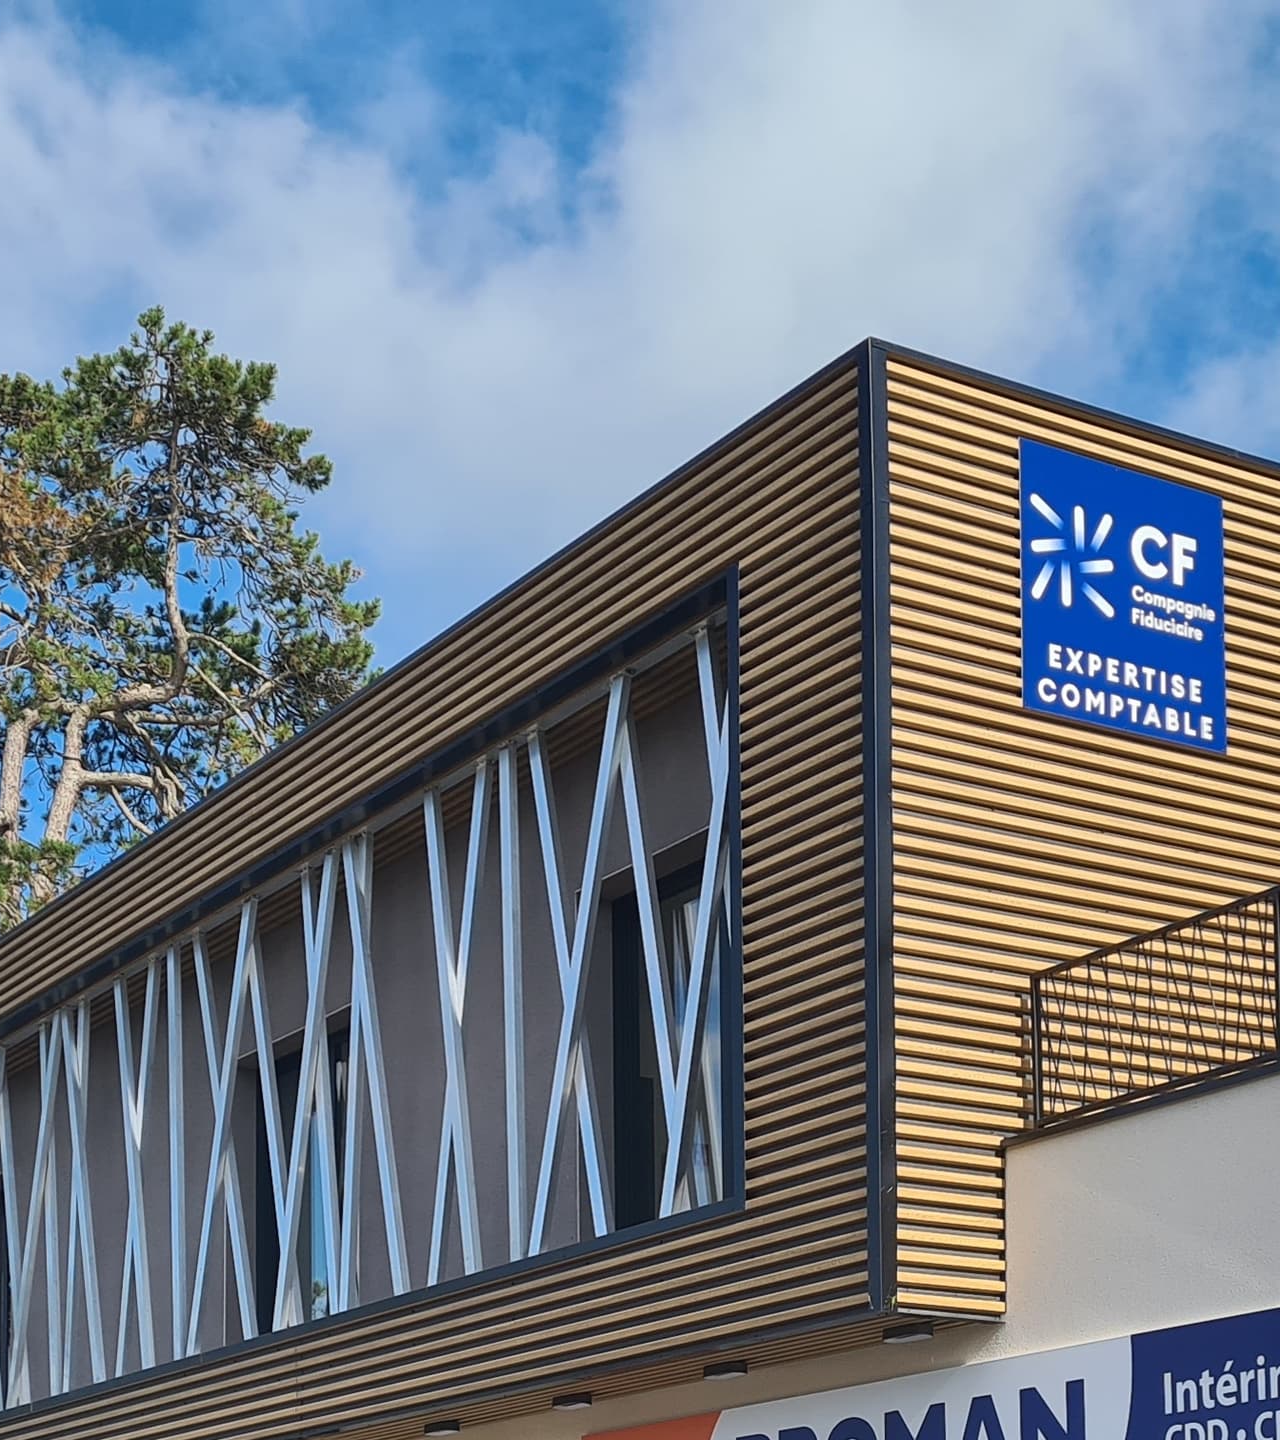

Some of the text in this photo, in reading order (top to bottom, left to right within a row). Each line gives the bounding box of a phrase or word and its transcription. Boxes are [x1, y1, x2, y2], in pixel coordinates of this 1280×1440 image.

[1131, 525, 1197, 586] CF
[1132, 585, 1215, 622] Compagnie
[1132, 608, 1203, 641] Fiduciaire
[1048, 643, 1202, 703] EXPERTISE
[1037, 677, 1213, 740] COMPTABLE
